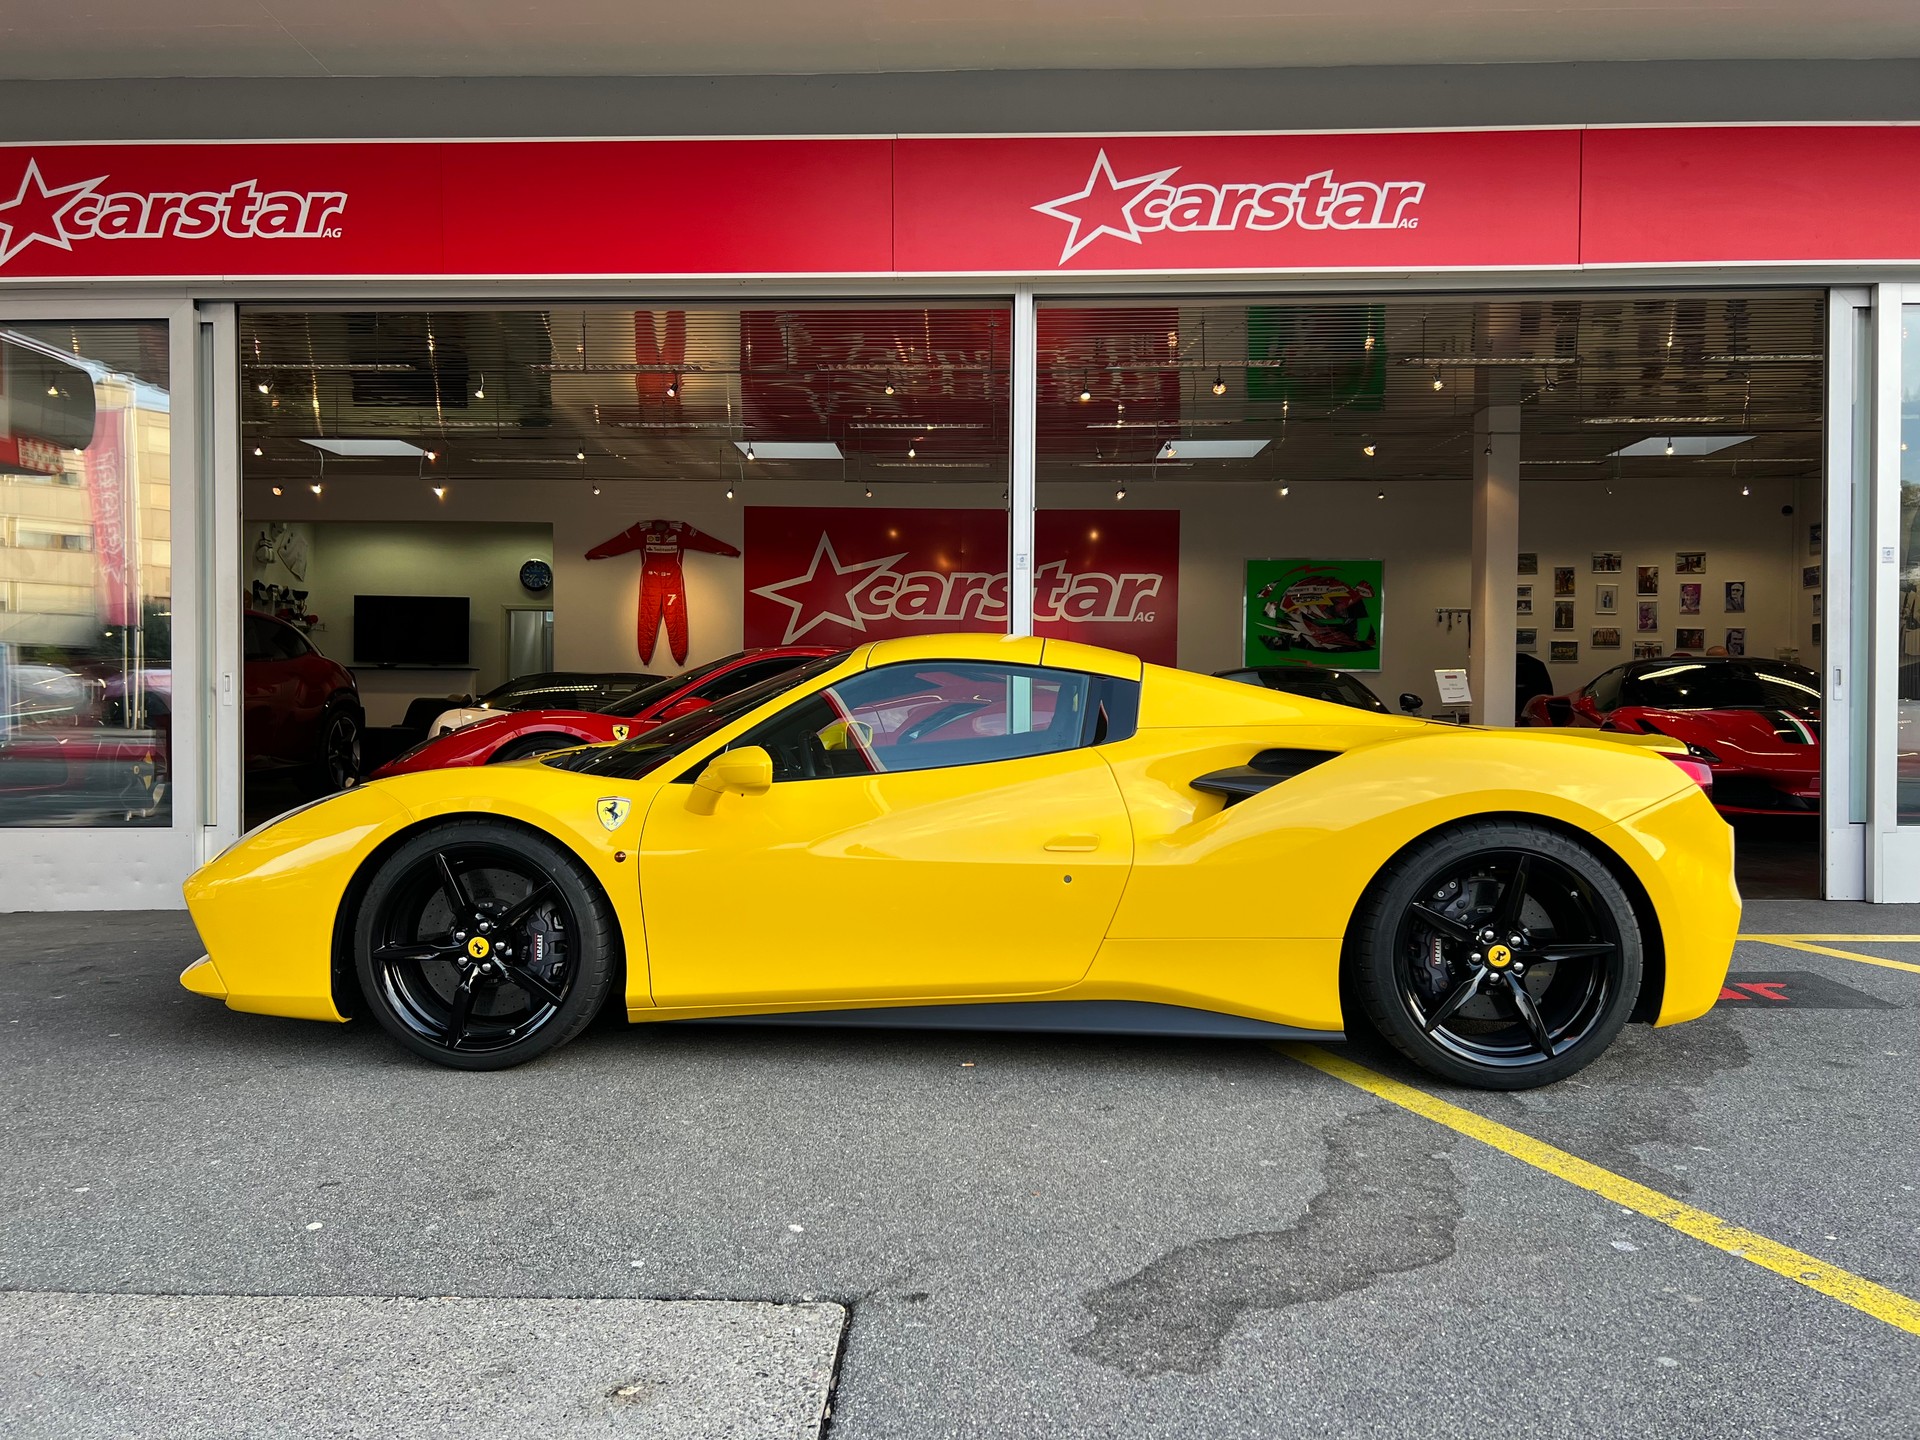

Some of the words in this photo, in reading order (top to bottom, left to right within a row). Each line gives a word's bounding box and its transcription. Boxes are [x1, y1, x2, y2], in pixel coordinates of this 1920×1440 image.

[63, 178, 348, 239] carstar
[322, 228, 343, 239] AG
[1126, 169, 1426, 232] carstar
[1397, 217, 1419, 229] AG
[667, 594, 677, 606] 7
[851, 559, 1163, 622] carstar
[1133, 611, 1156, 623] AG
